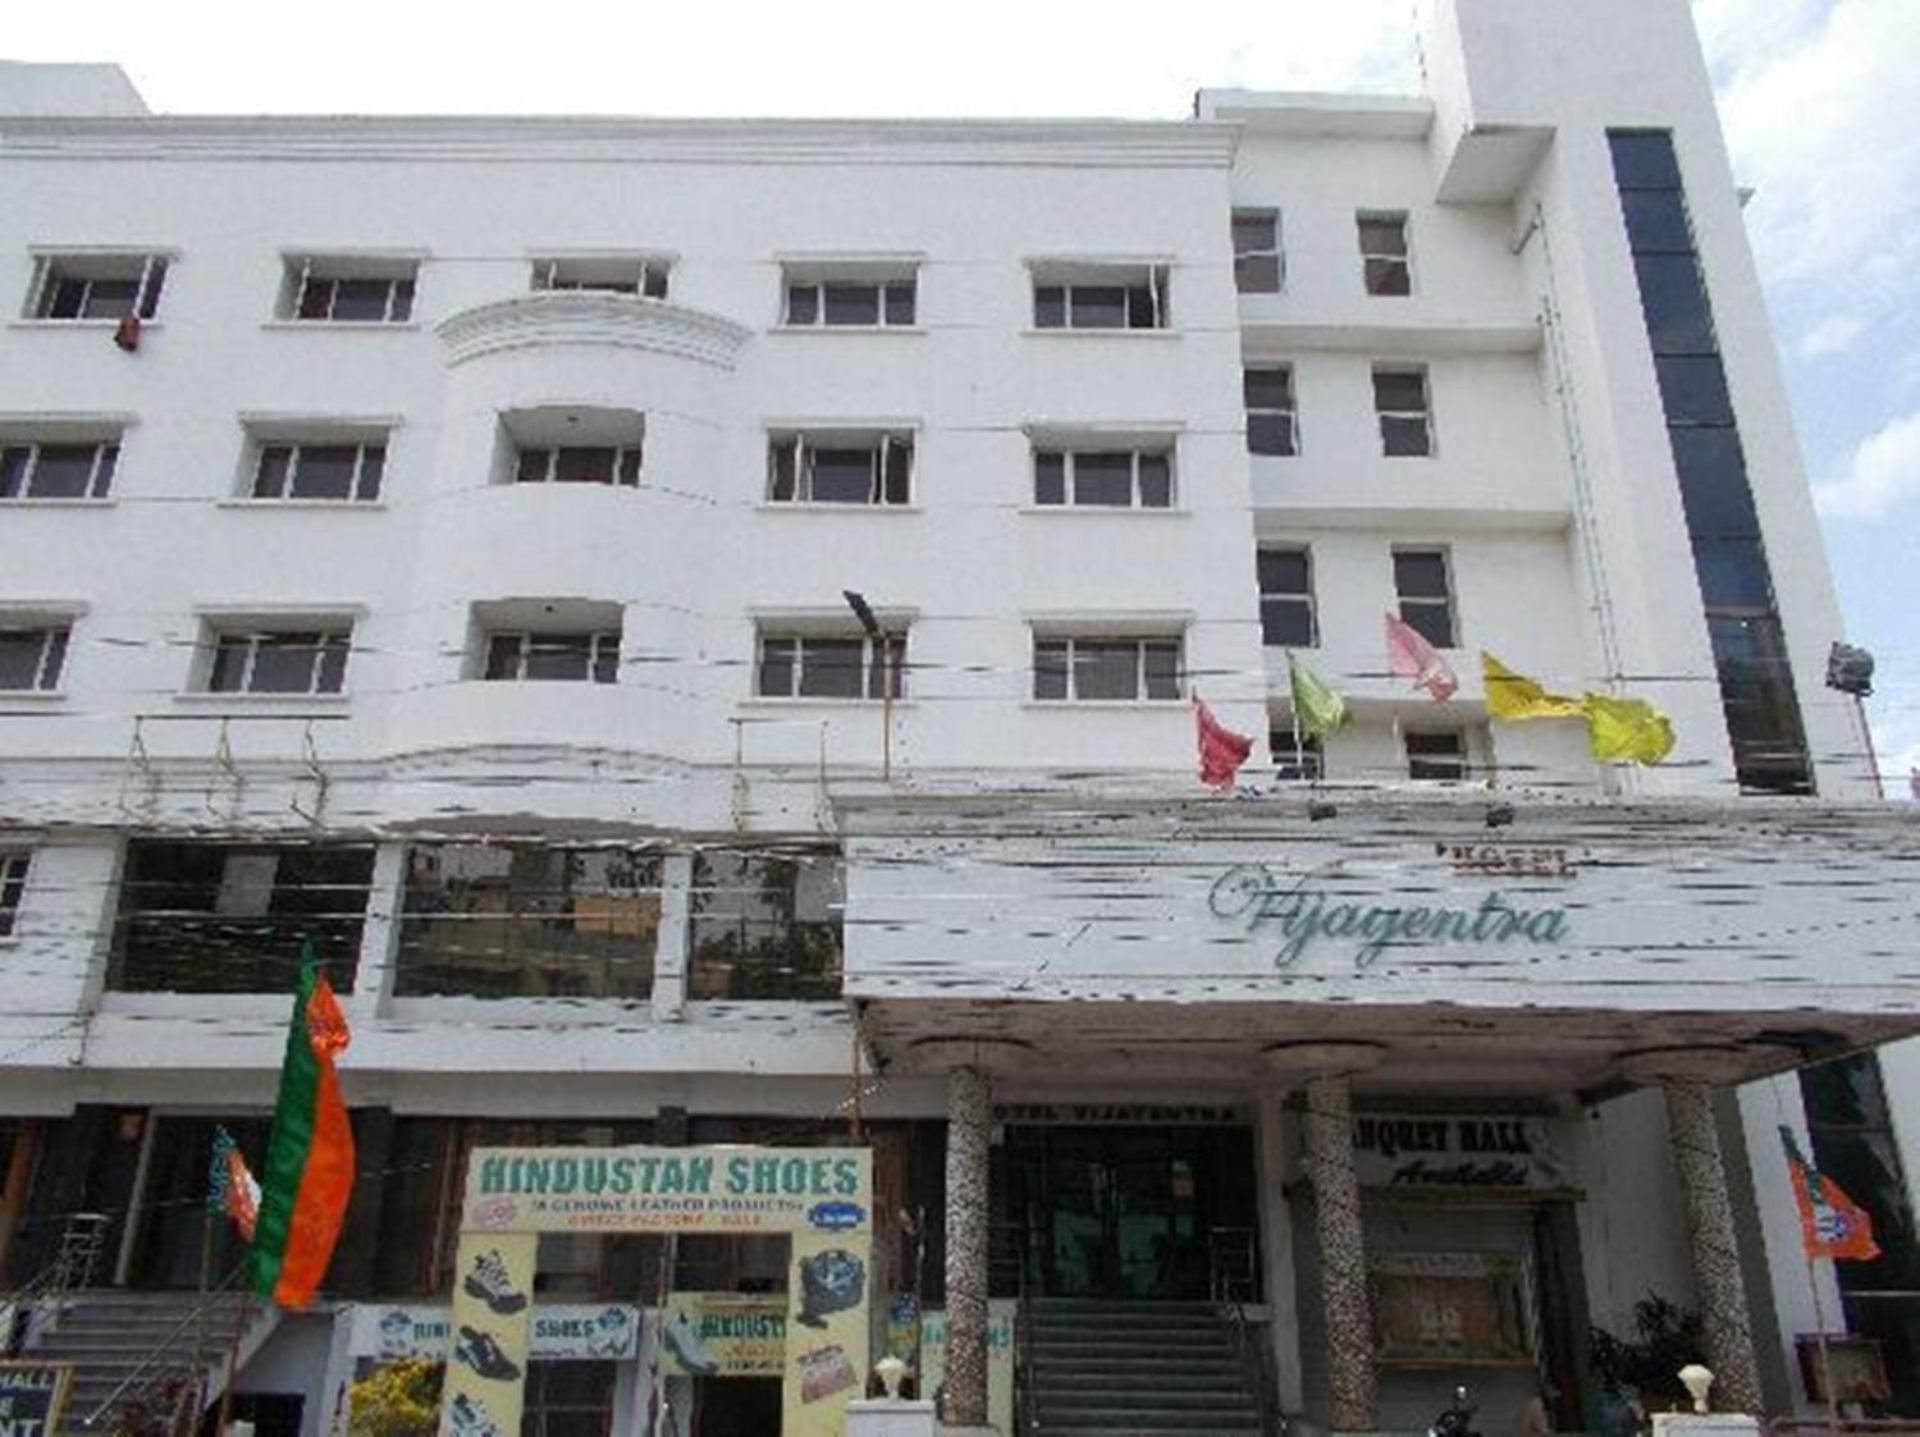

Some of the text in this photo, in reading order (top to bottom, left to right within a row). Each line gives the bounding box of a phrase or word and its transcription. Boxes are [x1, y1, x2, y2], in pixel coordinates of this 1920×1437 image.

[993, 1103, 1058, 1121] OTEL
[1458, 1120, 1533, 1154] HALL
[479, 1157, 859, 1196] HINDUSTAN SHOES
[535, 1319, 596, 1339] SHOES
